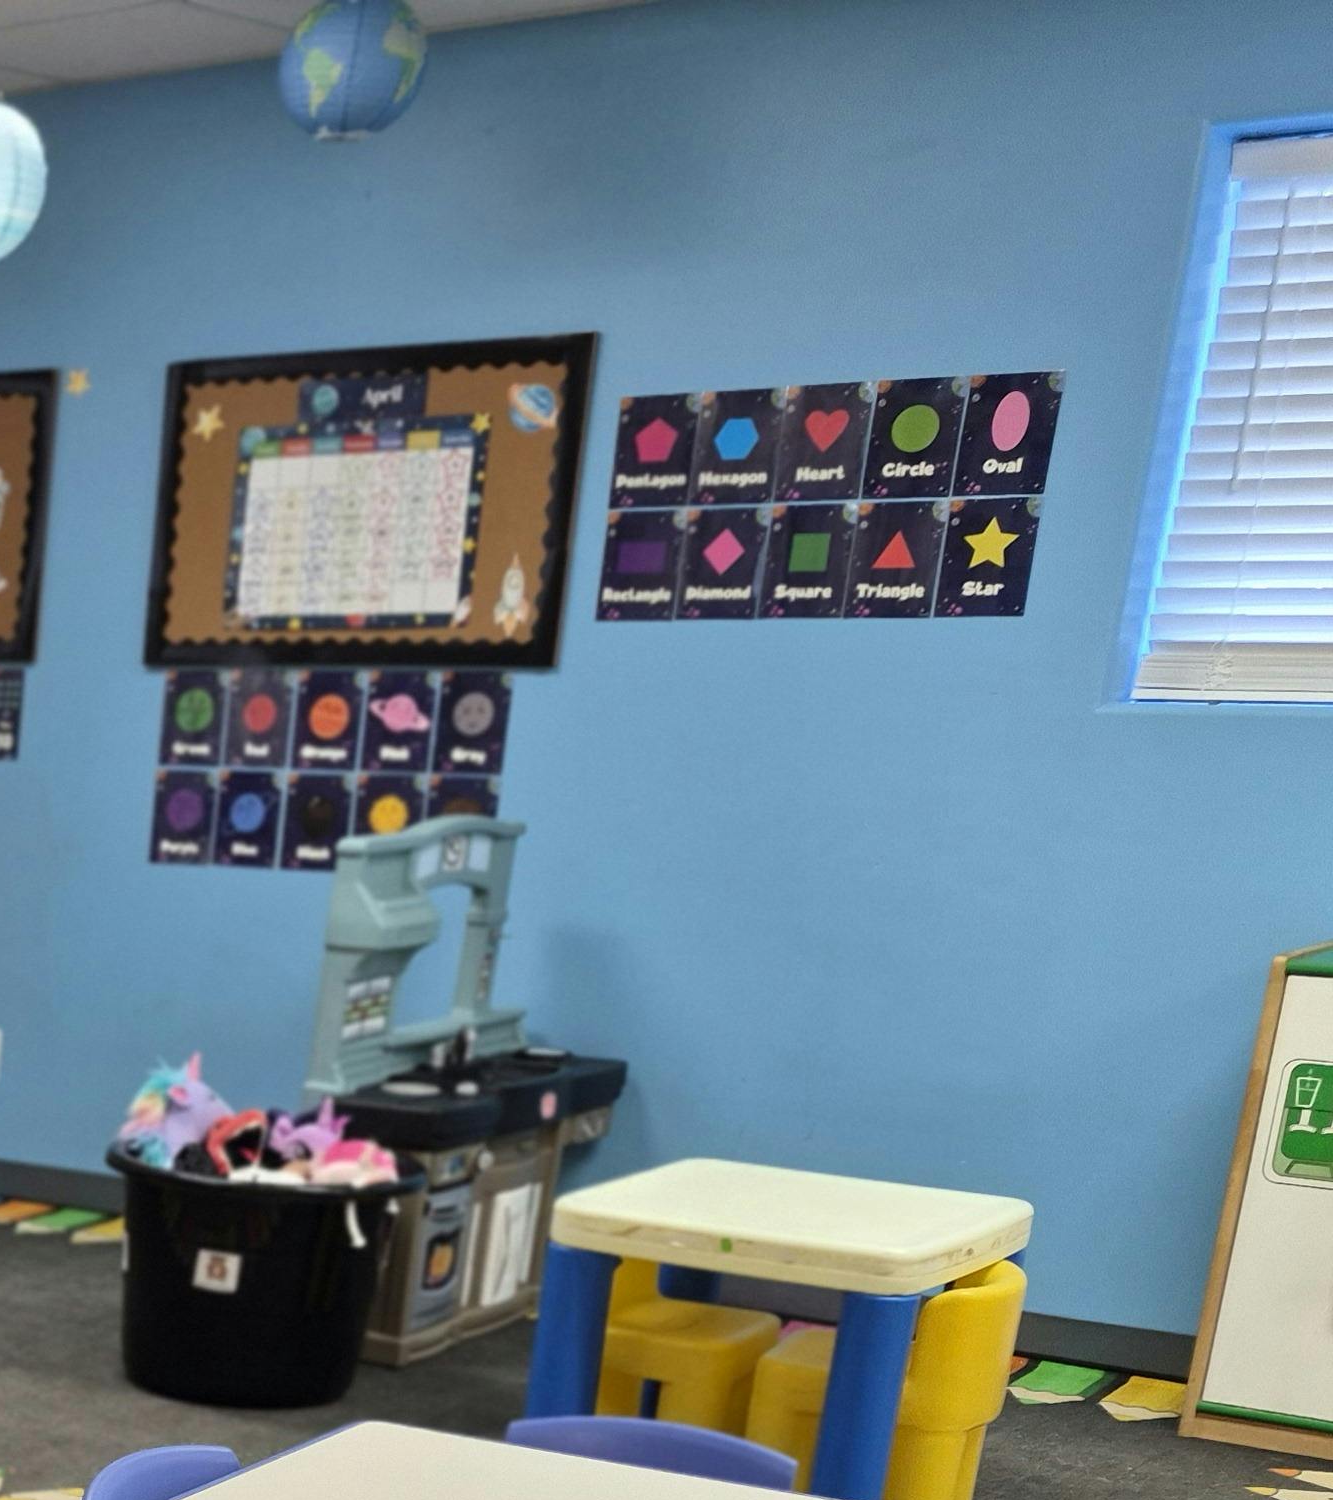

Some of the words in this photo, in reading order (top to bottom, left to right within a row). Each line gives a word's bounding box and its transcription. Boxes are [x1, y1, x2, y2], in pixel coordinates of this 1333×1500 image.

[362, 385, 404, 409] April
[795, 465, 845, 482] Heart
[881, 461, 935, 479] Circle
[982, 457, 1025, 476] Oval
[615, 470, 686, 490] Pentagon
[699, 469, 768, 488] Hexagon
[602, 586, 672, 604] Rectangle
[684, 584, 752, 602] Diamond
[774, 582, 833, 600] Square
[855, 582, 925, 600] Triangle
[961, 580, 1004, 598] Star
[172, 743, 212, 757] Green
[244, 742, 270, 757] Red
[300, 745, 348, 761] Orange
